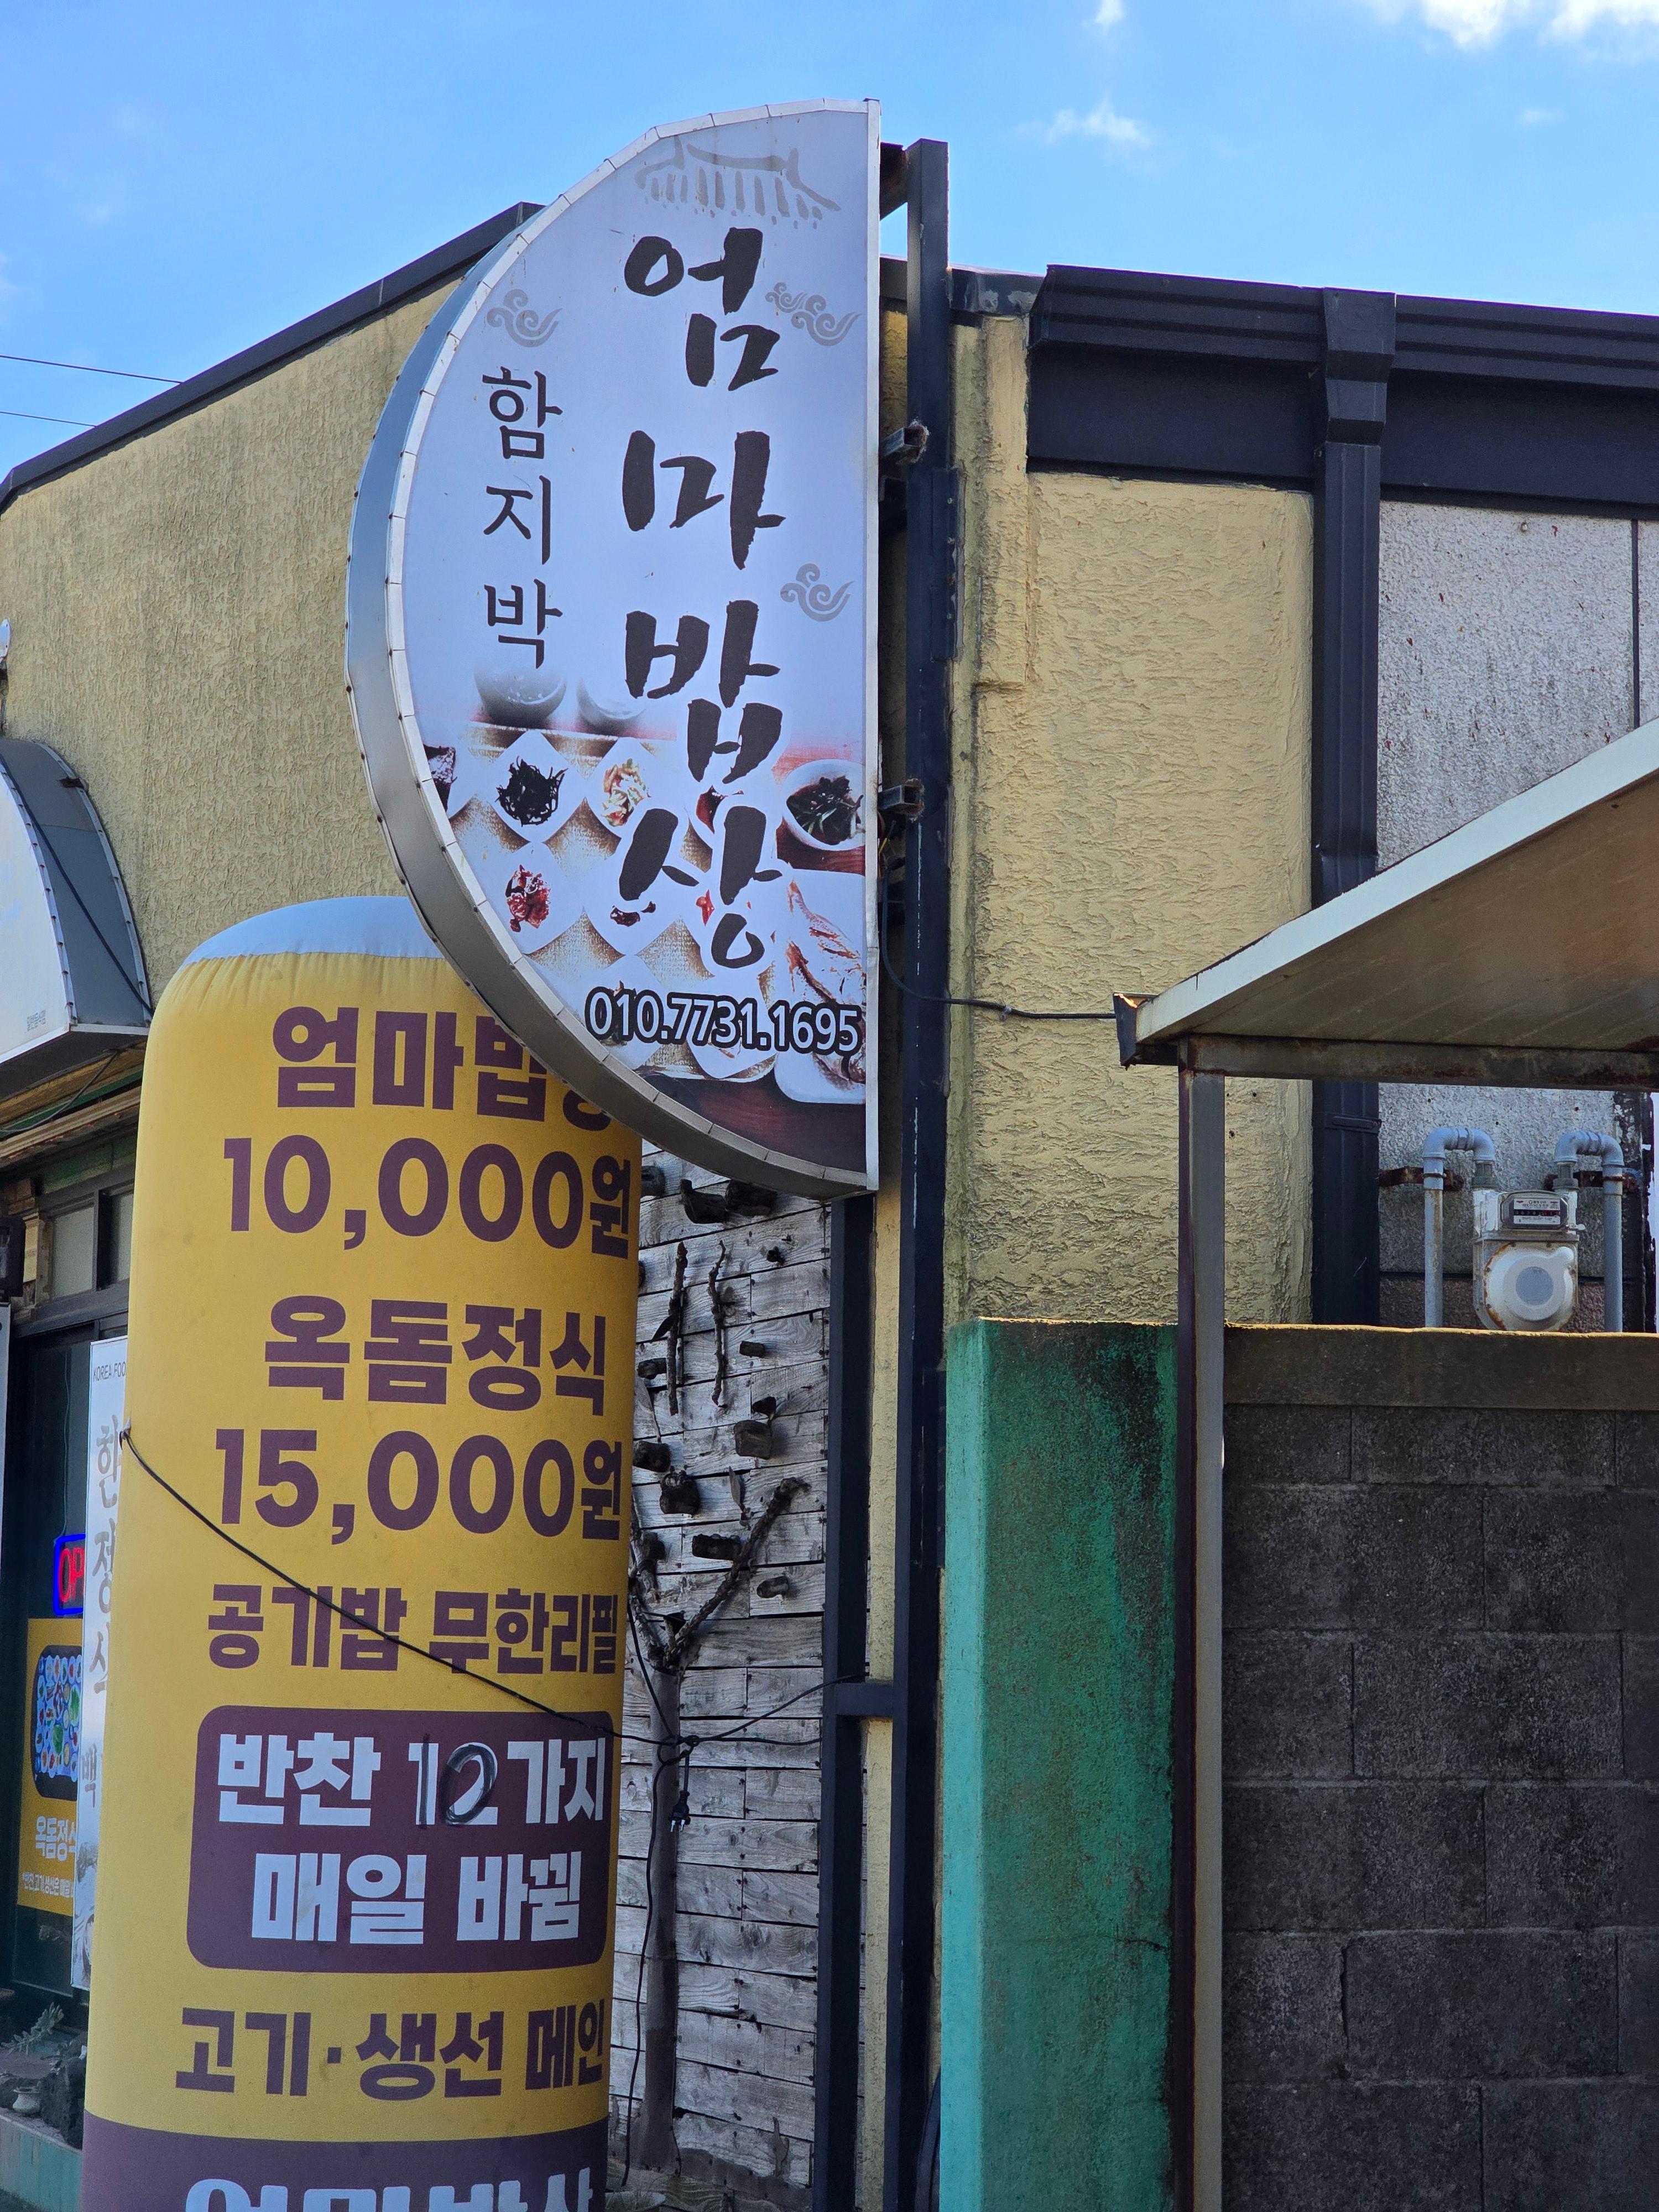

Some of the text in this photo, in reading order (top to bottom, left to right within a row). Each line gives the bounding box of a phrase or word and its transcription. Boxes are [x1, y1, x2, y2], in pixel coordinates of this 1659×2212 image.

[482, 366, 563, 669] 함지박
[585, 987, 862, 1055] 010.7731.1695
[224, 1135, 631, 1259] 10,000원
[93, 1364, 111, 1381] KOREA
[265, 1295, 606, 1416] 옥돔정식
[216, 1428, 622, 1545] 15,000원
[208, 1584, 618, 1674] 공기밥 무한리필
[218, 1732, 380, 1826] 반찬
[252, 1851, 581, 1944] 매일 바뀜
[525, 1999, 605, 2090] 메인
